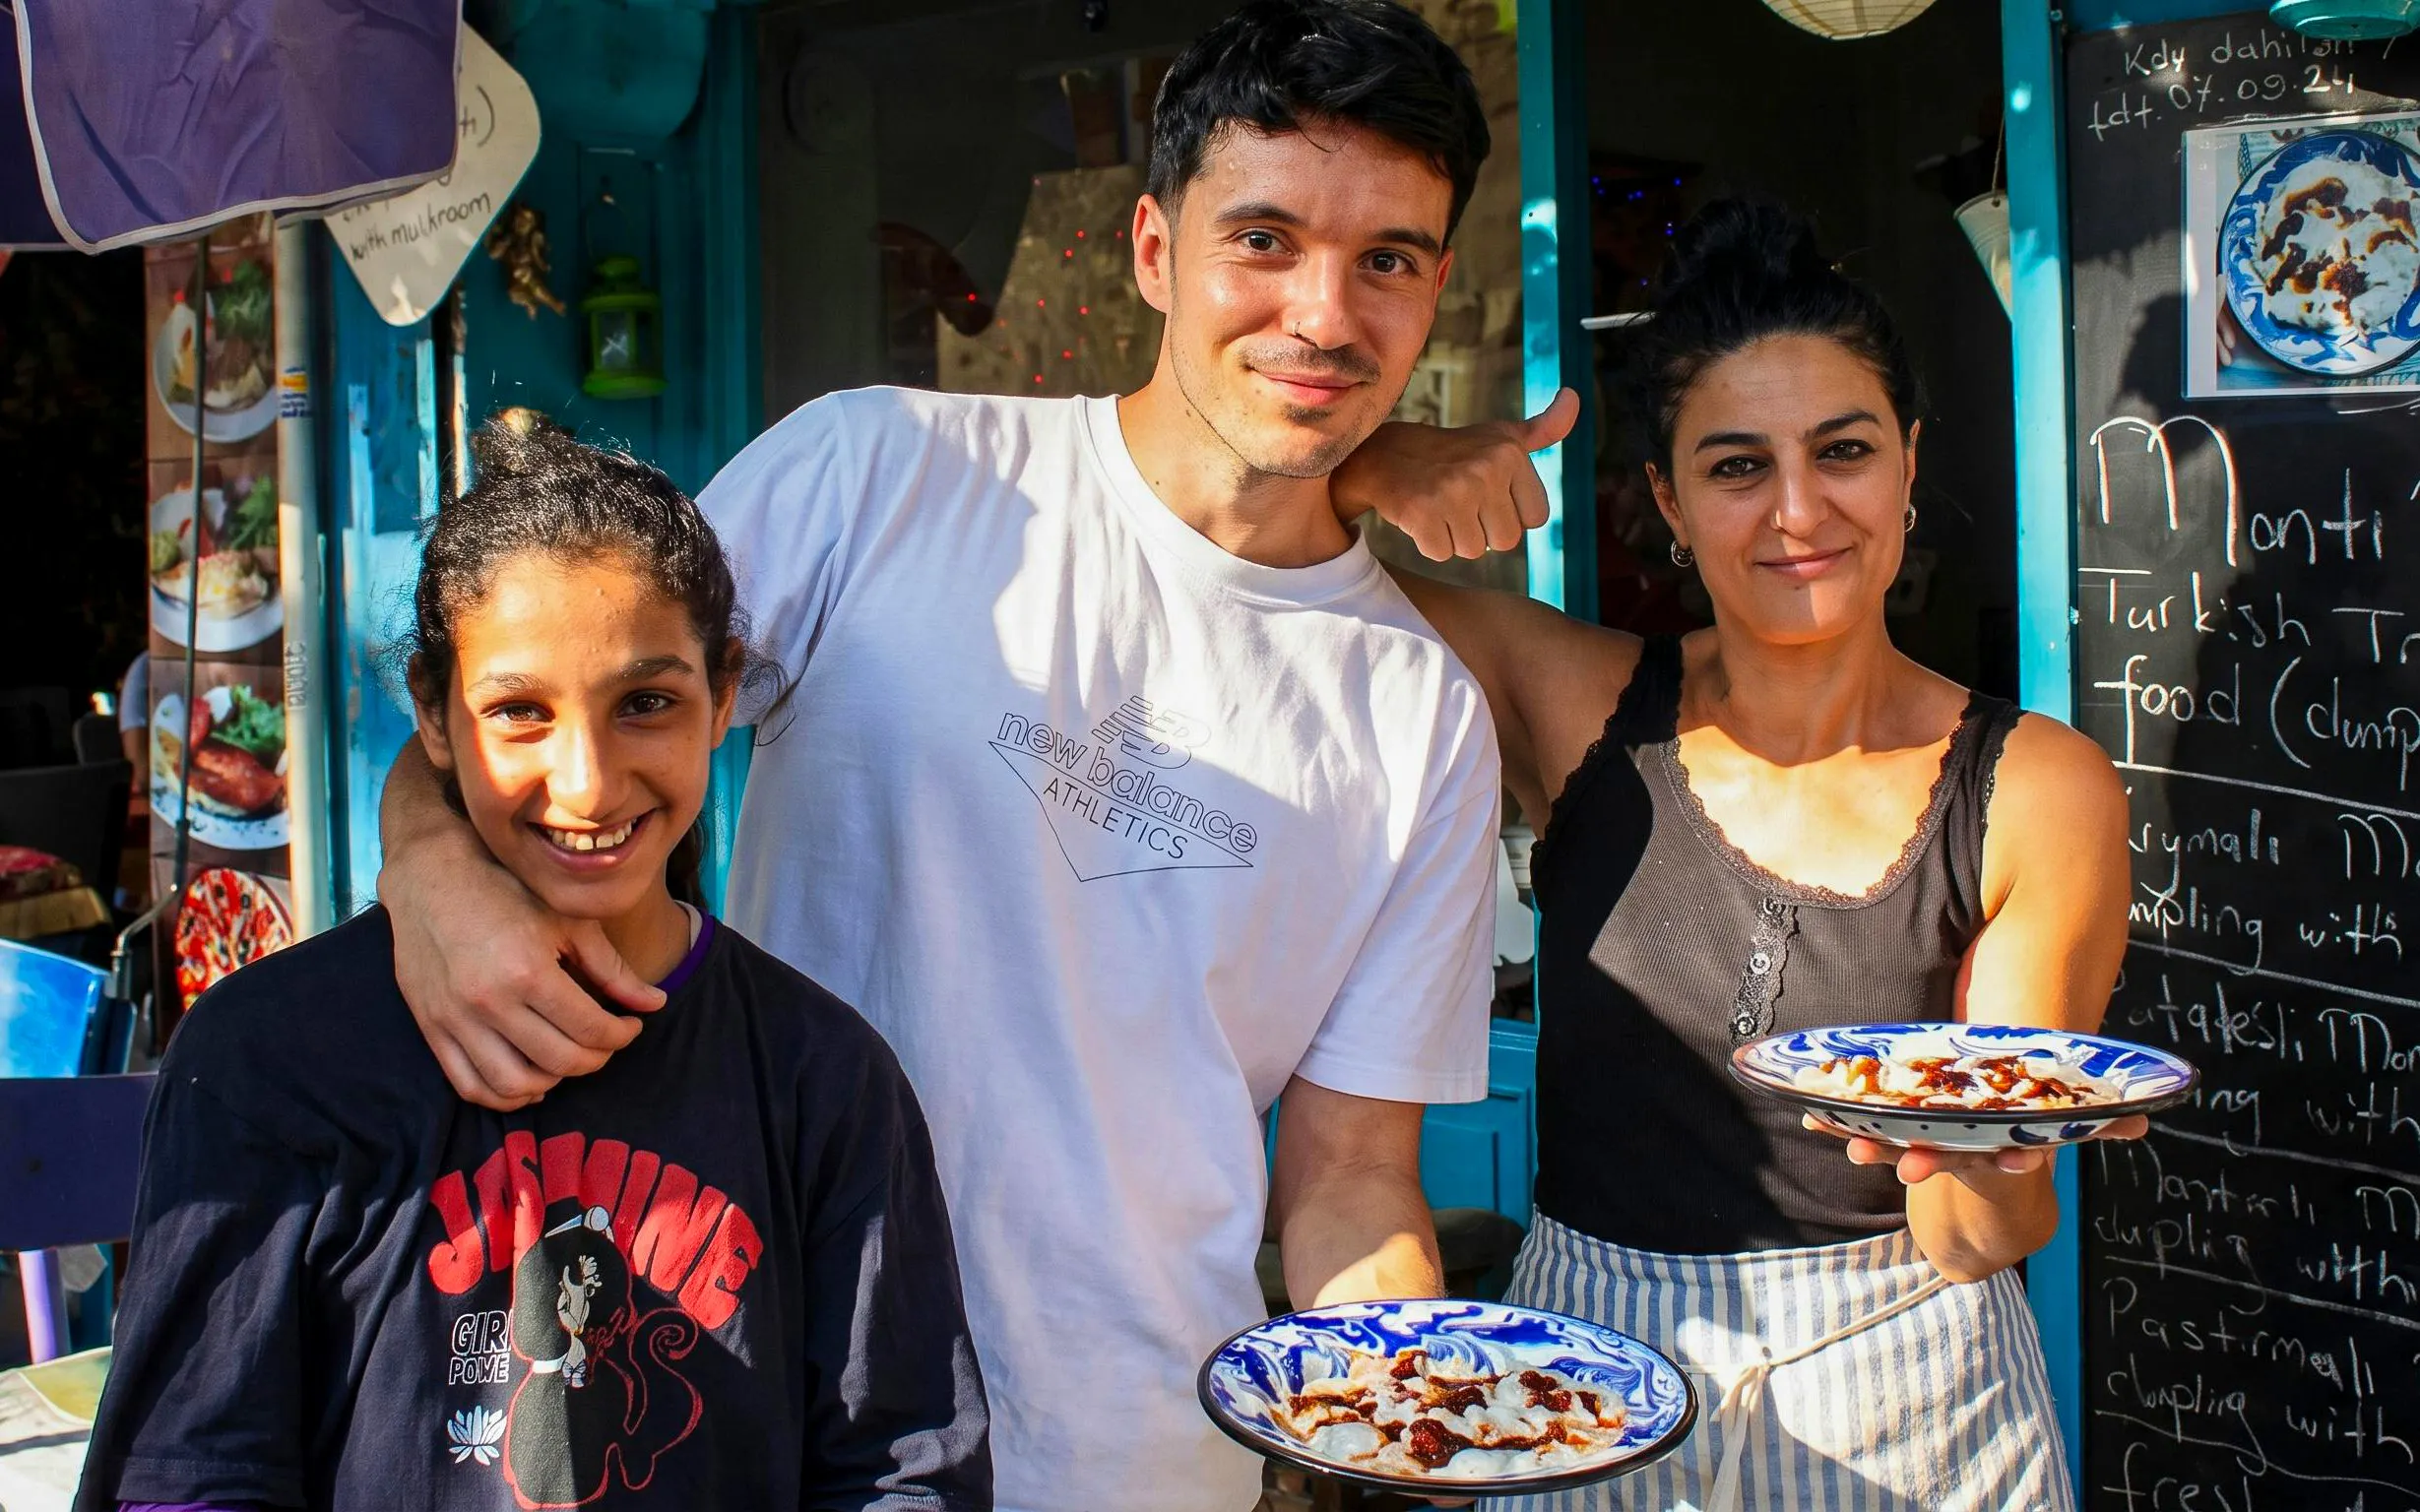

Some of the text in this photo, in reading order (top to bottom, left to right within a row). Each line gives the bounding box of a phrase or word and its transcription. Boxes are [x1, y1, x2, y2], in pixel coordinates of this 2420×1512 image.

[2078, 567, 2312, 649] Turkish
[2093, 655, 2241, 765] food
[996, 712, 1258, 853] new balance
[1043, 777, 1188, 859] ATHLETICS
[2305, 1081, 2420, 1148] with
[451, 1308, 514, 1356] GIR
